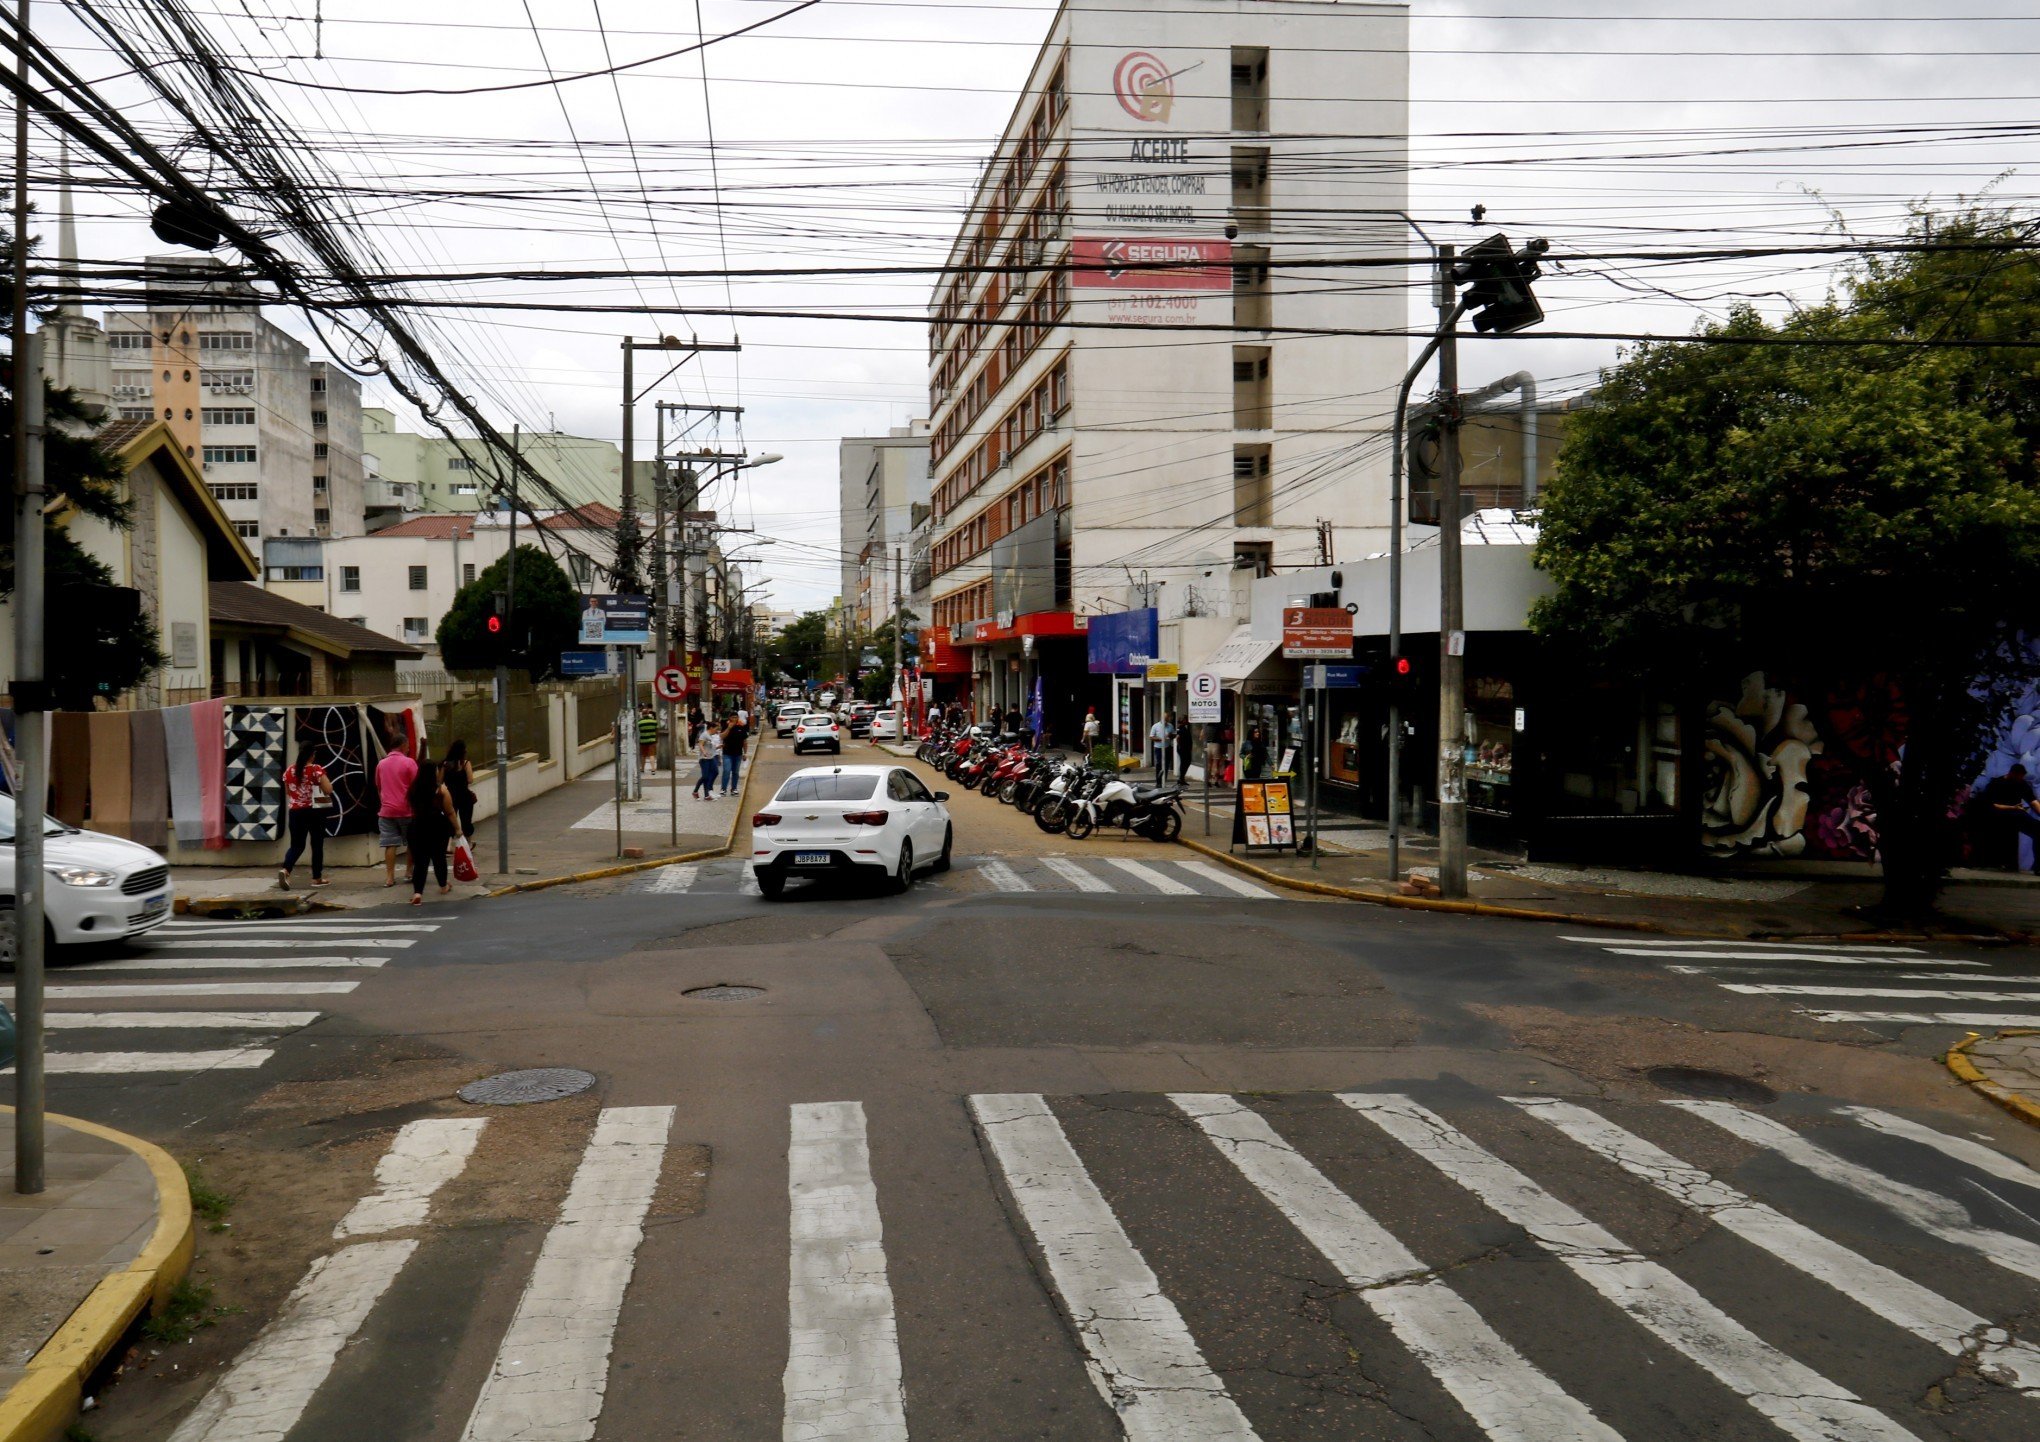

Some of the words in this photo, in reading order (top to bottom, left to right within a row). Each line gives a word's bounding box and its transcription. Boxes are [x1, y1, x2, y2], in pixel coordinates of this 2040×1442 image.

[1130, 139, 1189, 165] ACERTE
[1096, 174, 1107, 193] NA
[1108, 174, 1129, 193] HORA
[1130, 174, 1140, 193] DE
[1141, 174, 1171, 196] VENDER,
[1171, 175, 1206, 194] COMPRAR
[1127, 245, 1201, 263] SEGURA
[1129, 294, 1198, 310] 2102.4000
[1108, 313, 1196, 325] www.segura.com.br
[1199, 678, 1210, 693] E
